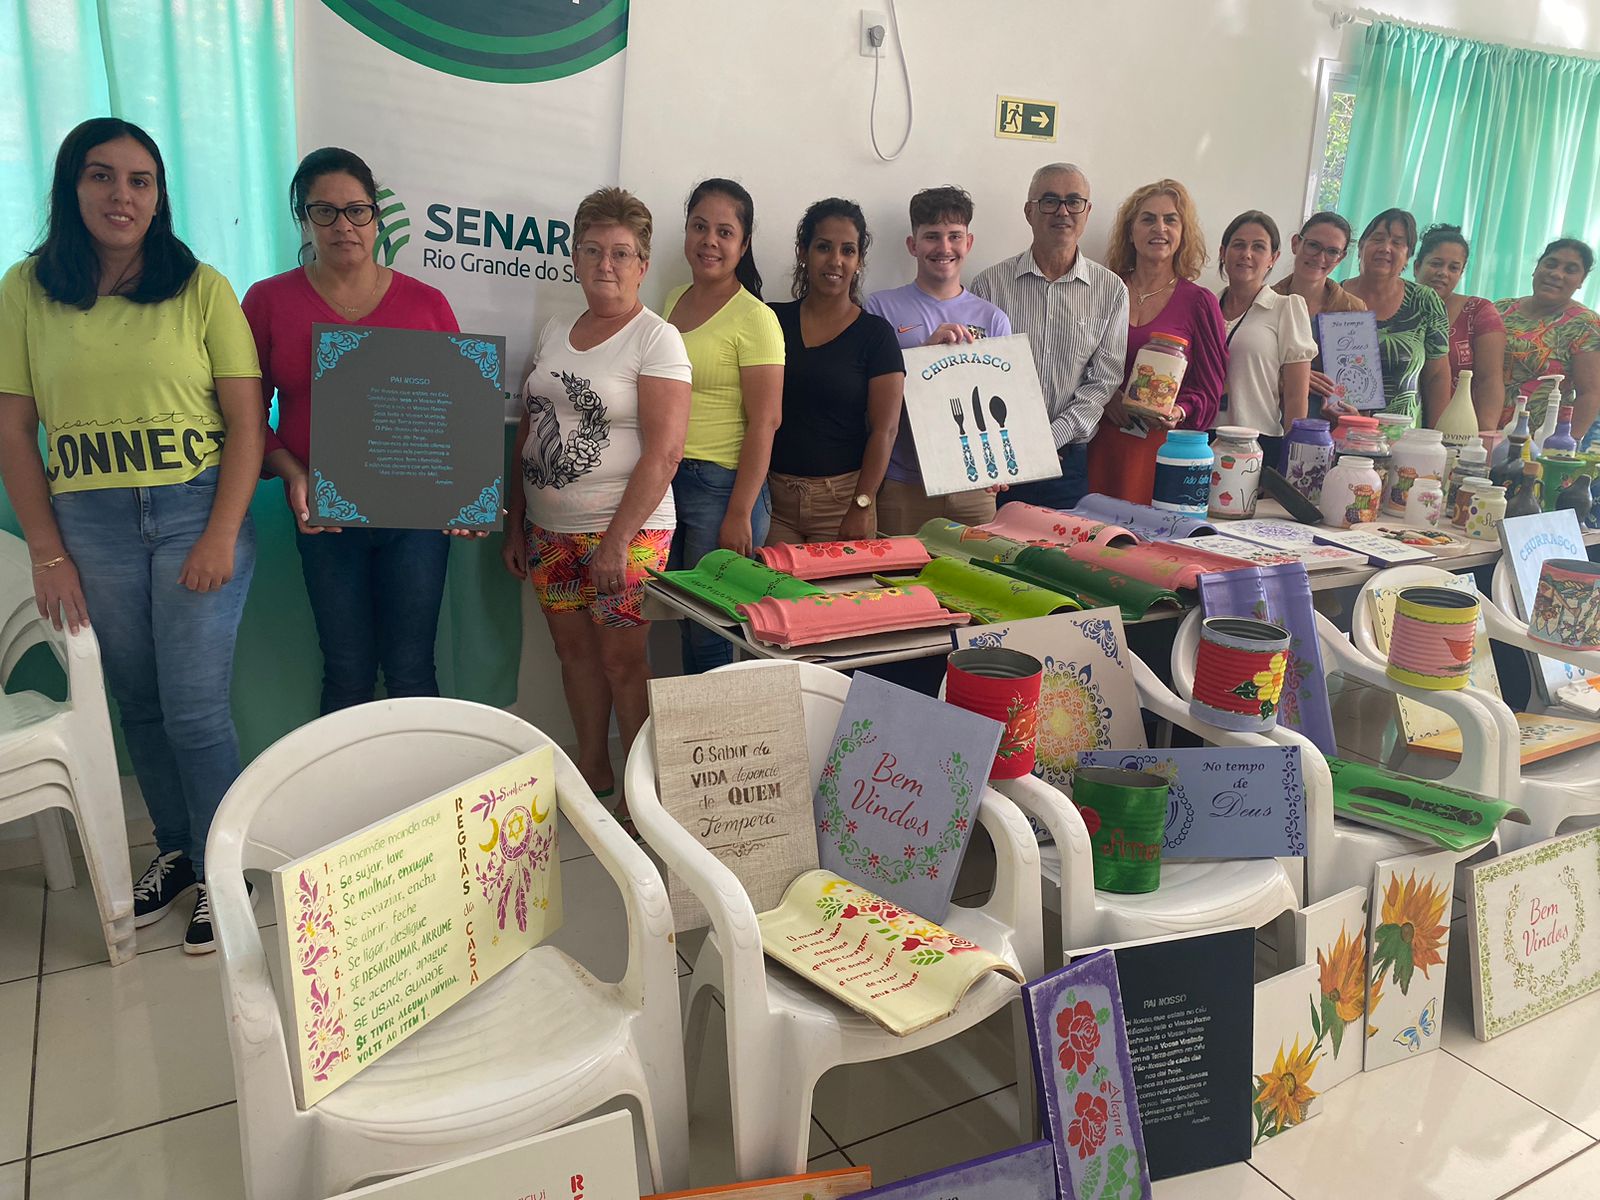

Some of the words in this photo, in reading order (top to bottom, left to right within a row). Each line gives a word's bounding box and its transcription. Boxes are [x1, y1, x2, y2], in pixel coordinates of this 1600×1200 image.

[424, 203, 571, 257] SENAR
[423, 248, 456, 270] Rio
[460, 252, 531, 278] Grande
[535, 260, 559, 281] do
[390, 376, 402, 384] PAI
[404, 377, 431, 385] NOSSO
[921, 353, 1011, 381] CHURRASCO
[1520, 533, 1577, 561] CHURRASCO
[693, 746, 704, 765] O
[708, 744, 748, 763] Sabor
[753, 741, 772, 756] da
[1202, 762, 1221, 772] No
[1226, 762, 1265, 774] tempo
[691, 769, 728, 789] VIDA
[731, 763, 780, 786] depende
[872, 752, 924, 797] Bem
[1233, 778, 1249, 789] de
[698, 795, 715, 809] de
[728, 782, 781, 806] QUEM
[851, 779, 929, 837] Vindos
[1209, 790, 1272, 818] Deus
[697, 812, 777, 838] Tempera
[339, 855, 348, 869] A
[349, 838, 386, 863] mamãe
[388, 822, 420, 846] manda
[421, 812, 441, 830] aqui
[454, 797, 471, 896] REGRAS
[340, 874, 353, 889] Se
[386, 848, 405, 865] lave
[342, 893, 356, 910] Se
[397, 852, 434, 880] enxugue
[344, 915, 357, 931] Se
[407, 873, 437, 896] encha
[1530, 897, 1558, 925] Bem
[346, 937, 359, 951] Se
[392, 903, 418, 924] feche
[798, 927, 824, 940] mundo
[826, 922, 842, 943] mãos
[1523, 918, 1569, 957] Vindos
[348, 956, 361, 972] Se
[390, 916, 427, 946] desligue
[350, 979, 360, 993] SE
[422, 918, 453, 947] ARRUME
[466, 921, 480, 986] CASA
[812, 962, 826, 972] que
[841, 933, 870, 960] coragem
[813, 941, 848, 957] daqueles
[846, 970, 872, 982] correr
[848, 953, 874, 969] sonhar
[353, 996, 366, 1012] Se
[416, 943, 449, 971] apague
[878, 972, 898, 984] viver
[354, 1014, 369, 1032] SE
[405, 964, 445, 997] GUARDE
[870, 989, 890, 1000] seus
[1143, 999, 1156, 1009] PAI
[1158, 994, 1187, 1007] NOSSO
[370, 1017, 395, 1039] TIVER
[398, 993, 429, 1021] ALGUMA
[357, 1040, 383, 1064] VOLTE
[386, 1030, 398, 1045] AO
[400, 1015, 419, 1035] ITEM
